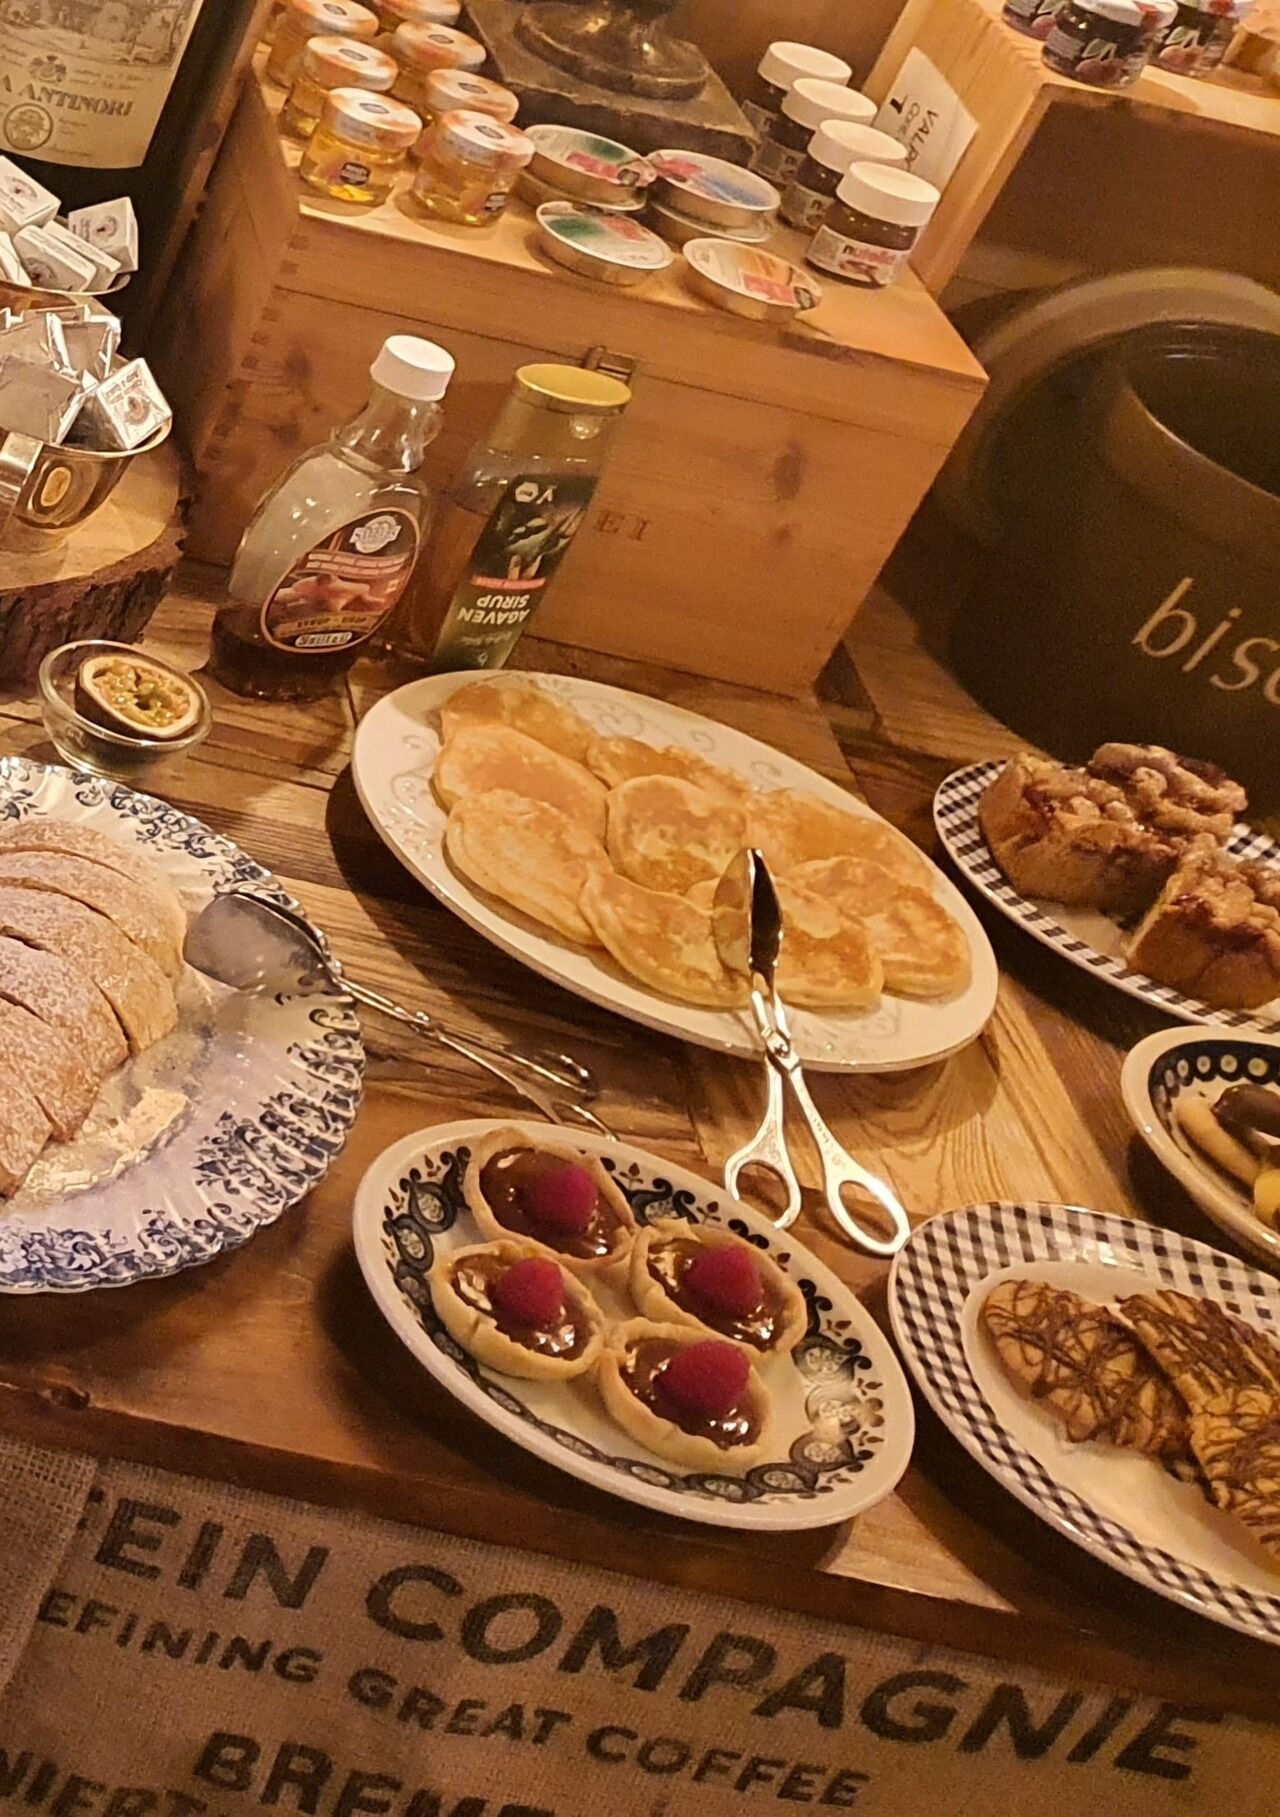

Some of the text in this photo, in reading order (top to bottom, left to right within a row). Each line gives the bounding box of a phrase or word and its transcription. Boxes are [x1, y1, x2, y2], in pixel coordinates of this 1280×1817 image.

[19, 82, 134, 117] ANTINORI
[457, 607, 531, 625] AGAVEN
[476, 594, 531, 609] SIRUP
[77, 1485, 1224, 1780] EIN COMPAGNIE
[347, 1666, 572, 1746] GREAT
[585, 1723, 871, 1808] COFFEE
